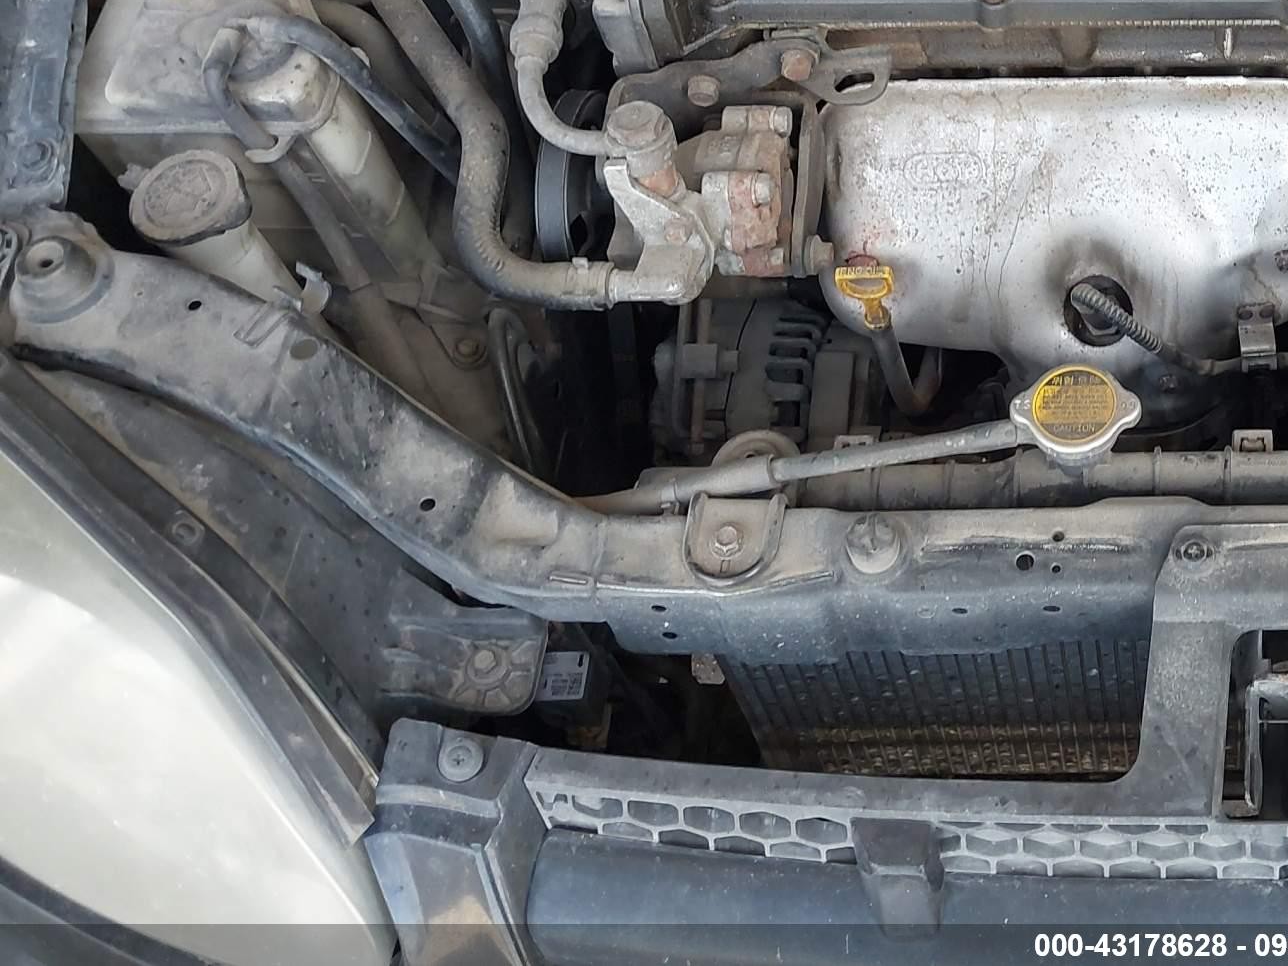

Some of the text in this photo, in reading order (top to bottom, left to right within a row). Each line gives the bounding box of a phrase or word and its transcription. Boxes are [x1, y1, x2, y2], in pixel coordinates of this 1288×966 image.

[840, 265, 884, 276] ENG OIL
[1053, 423, 1096, 433] CAUTION
